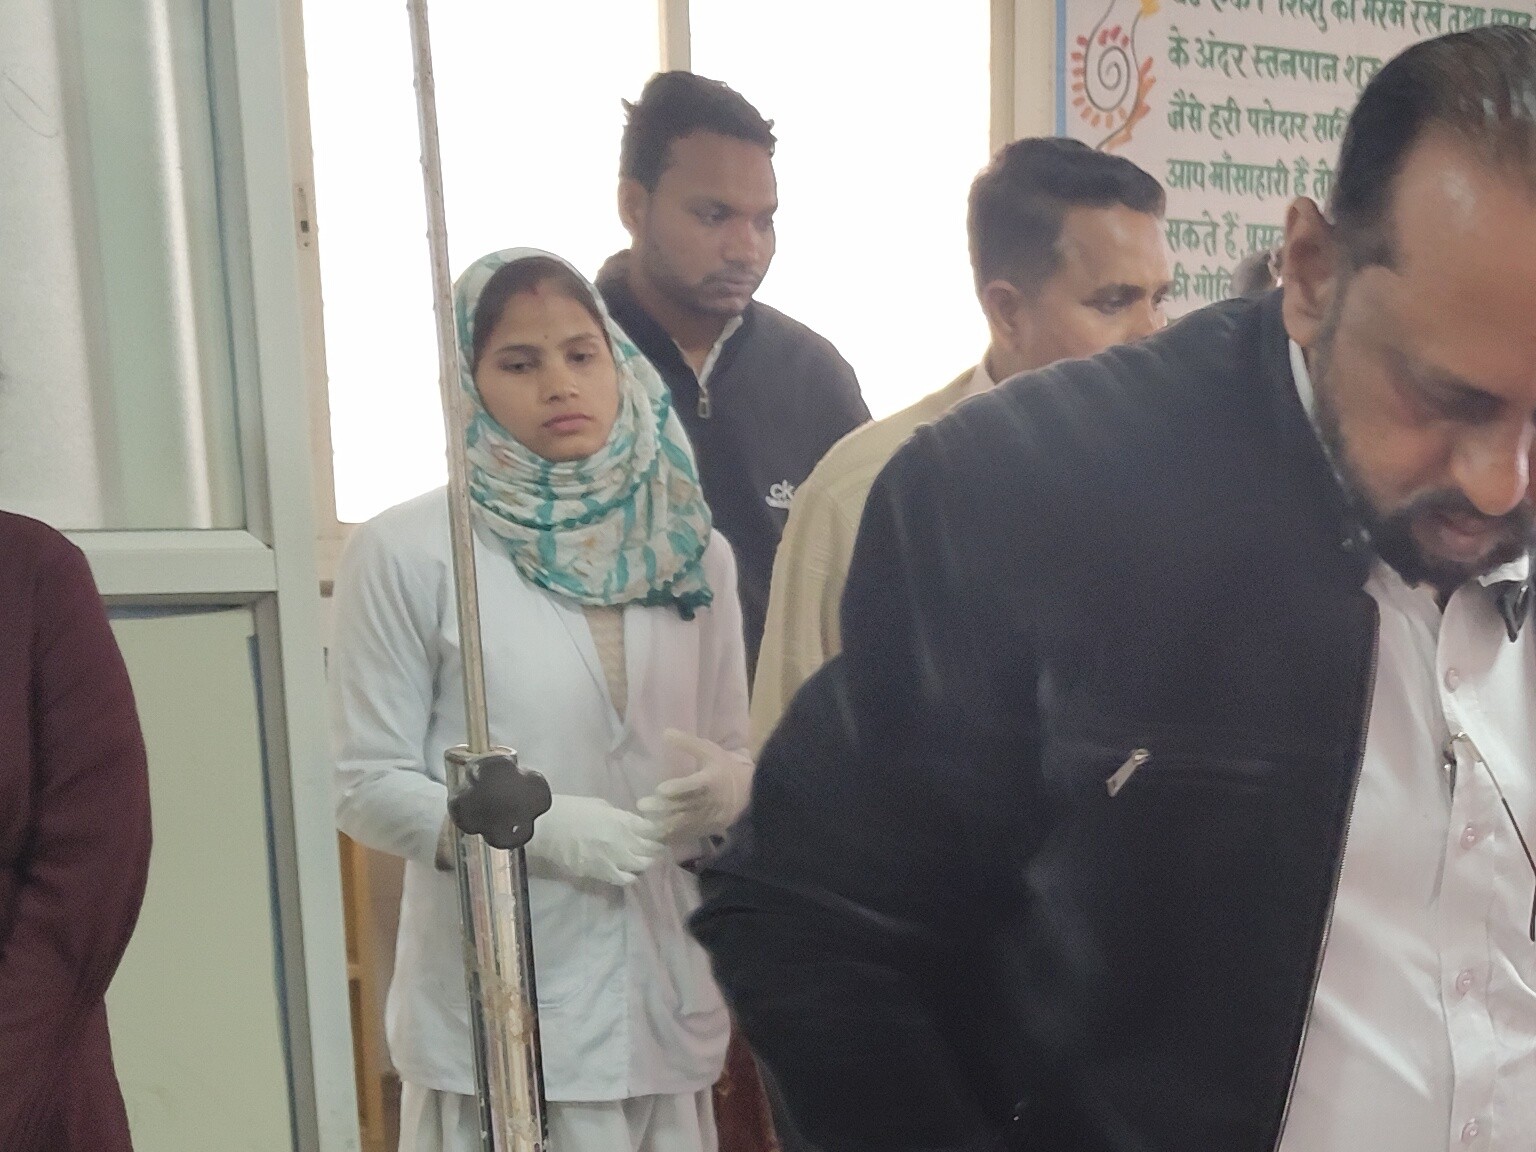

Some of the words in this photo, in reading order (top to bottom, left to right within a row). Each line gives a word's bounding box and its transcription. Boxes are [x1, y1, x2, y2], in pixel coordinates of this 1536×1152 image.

[1168, 25, 1190, 70] के
[1194, 29, 1248, 78] अंदर
[1252, 44, 1340, 83] स्तनपान
[1167, 88, 1206, 134] जैसे
[1208, 96, 1241, 140] हरी
[1247, 98, 1309, 143] पत्तेदार
[1165, 158, 1206, 192] आप
[1165, 209, 1221, 257] सकते
